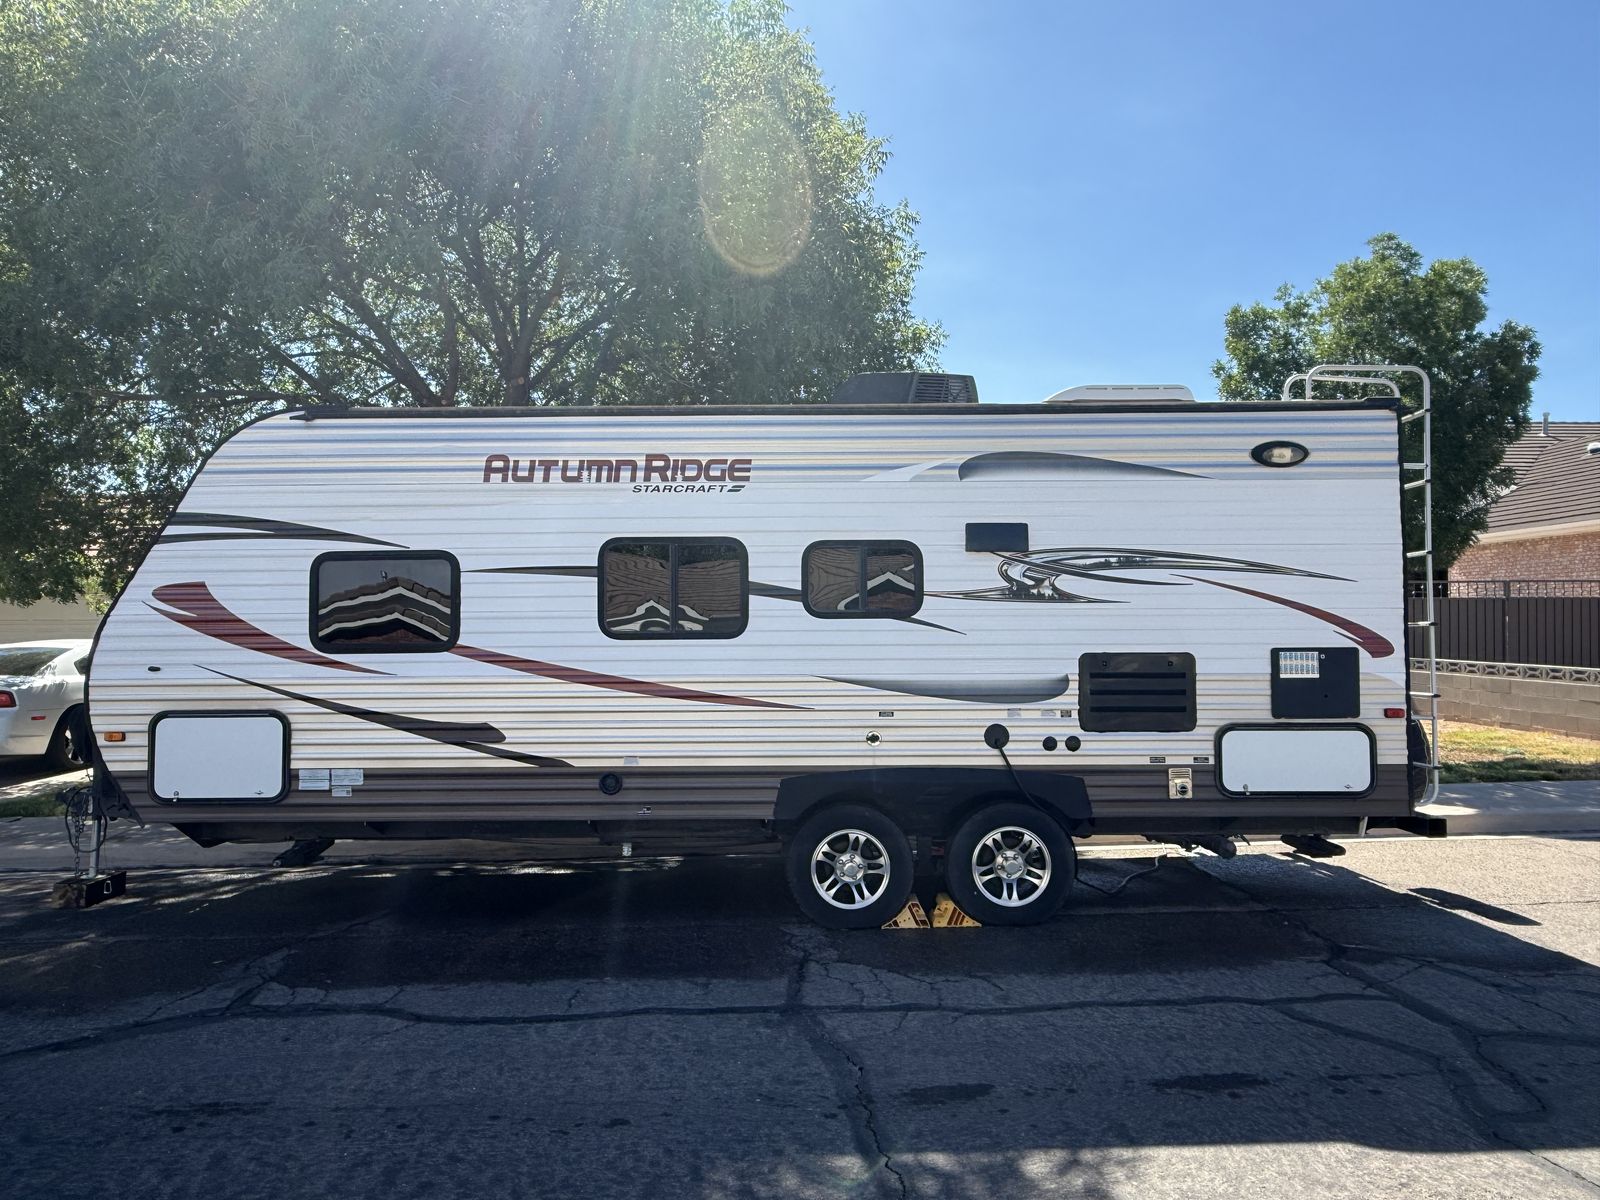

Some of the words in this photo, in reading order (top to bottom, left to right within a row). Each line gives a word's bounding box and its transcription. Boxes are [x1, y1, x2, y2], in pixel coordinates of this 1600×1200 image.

[483, 454, 638, 483] AUTUMN
[643, 453, 752, 483] RIDGE
[632, 484, 728, 493] STARCRAFT
